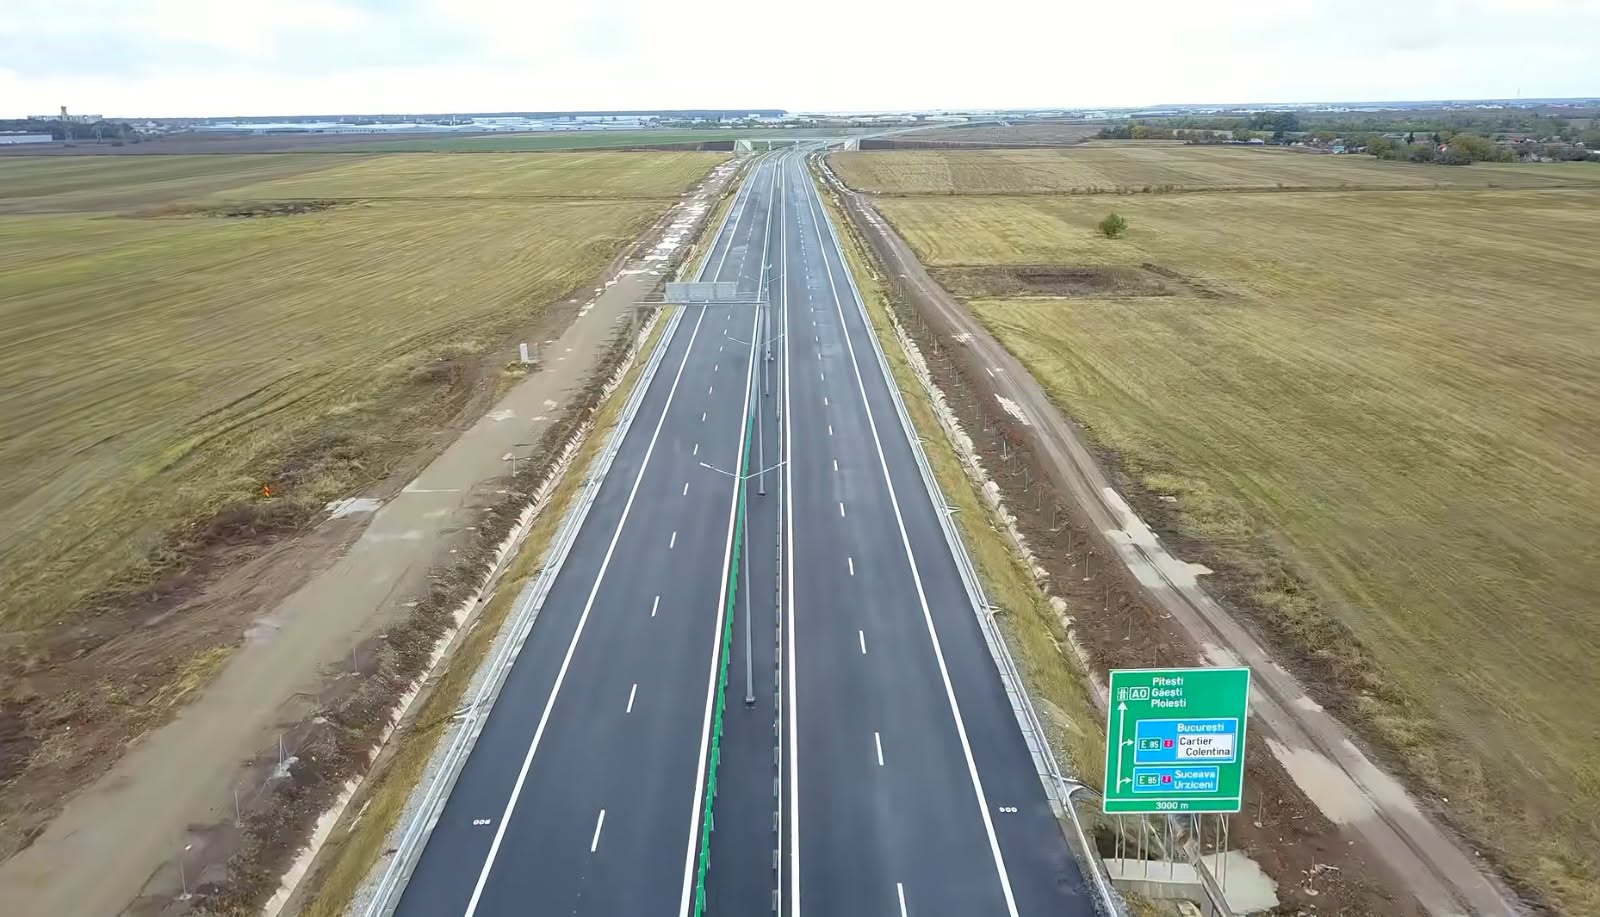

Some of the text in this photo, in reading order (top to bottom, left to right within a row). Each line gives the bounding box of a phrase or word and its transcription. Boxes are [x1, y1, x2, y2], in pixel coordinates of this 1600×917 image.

[1177, 722, 1224, 733] București
[1141, 740, 1147, 749] E
[1179, 737, 1213, 746] Cartier
[1186, 748, 1231, 757] Colentina
[1175, 770, 1215, 778] Suceava
[1139, 776, 1145, 784] E
[1174, 780, 1213, 790] Urziceni
[1155, 801, 1178, 810] 3000
